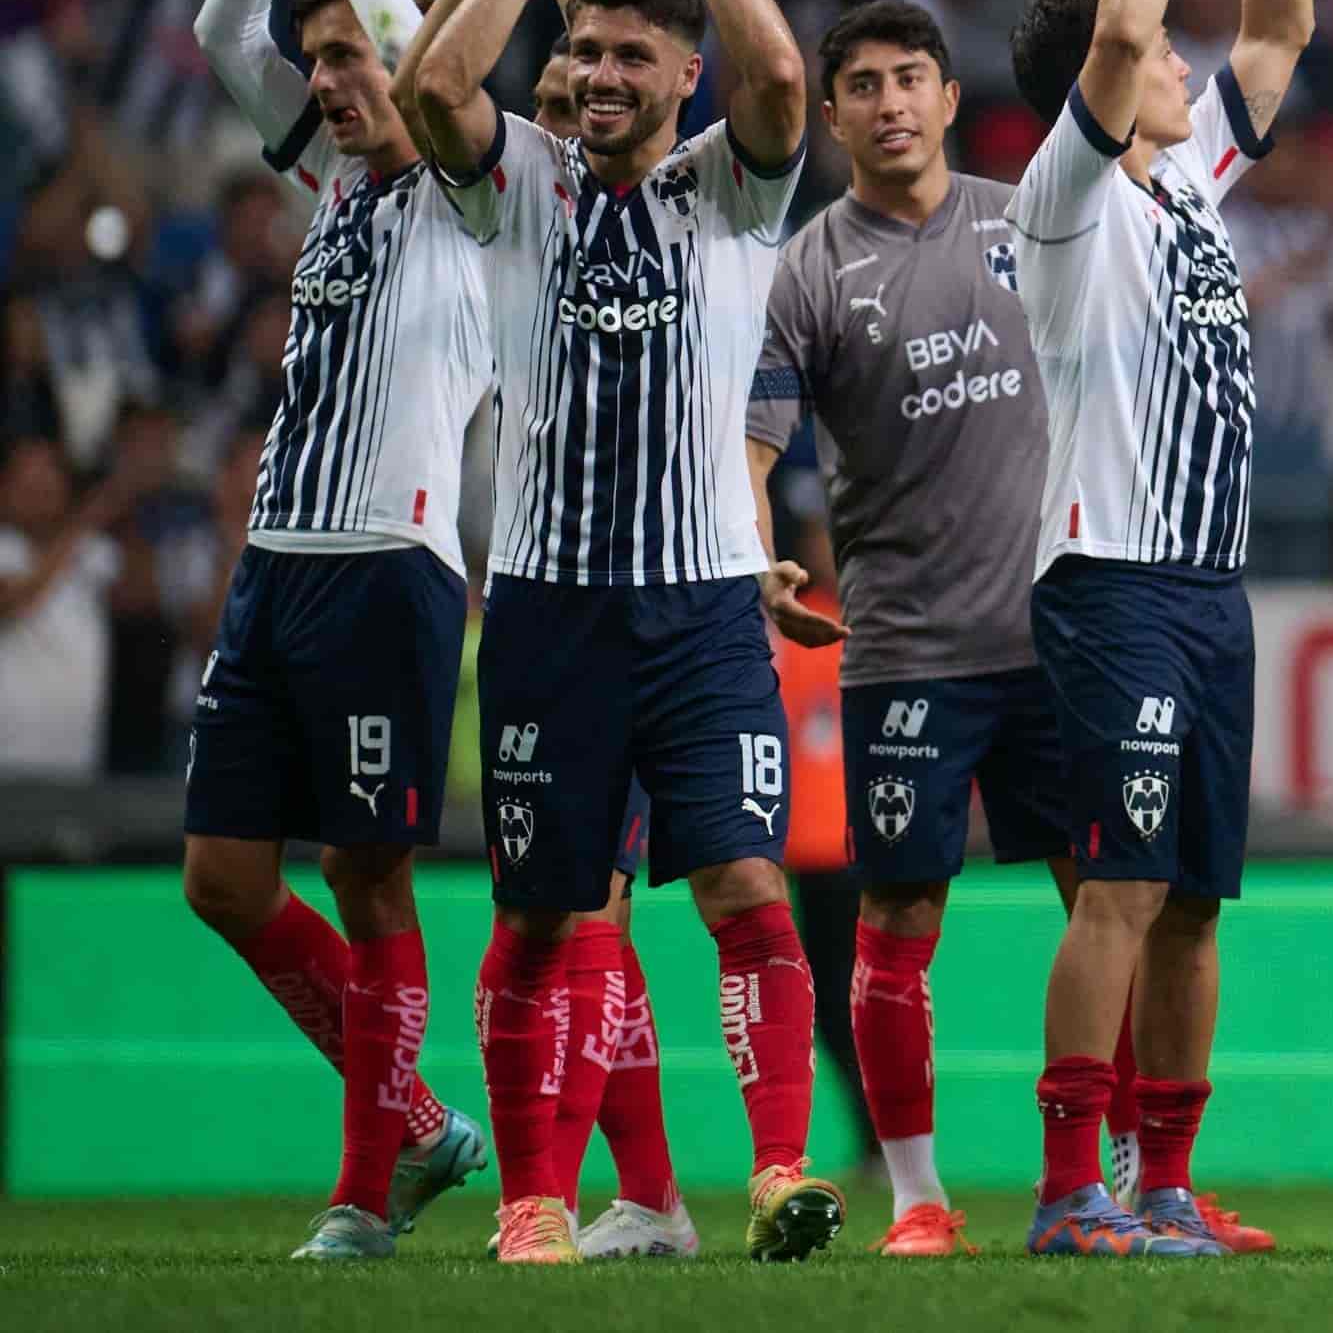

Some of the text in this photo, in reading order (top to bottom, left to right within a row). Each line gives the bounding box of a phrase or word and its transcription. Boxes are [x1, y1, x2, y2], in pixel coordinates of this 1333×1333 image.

[558, 294, 679, 333] codere
[905, 318, 999, 372] BBVA
[900, 367, 1022, 421] codere
[347, 715, 391, 775] 19
[738, 733, 783, 796] 18
[868, 742, 940, 759] nowports
[376, 985, 429, 1113] Escudo
